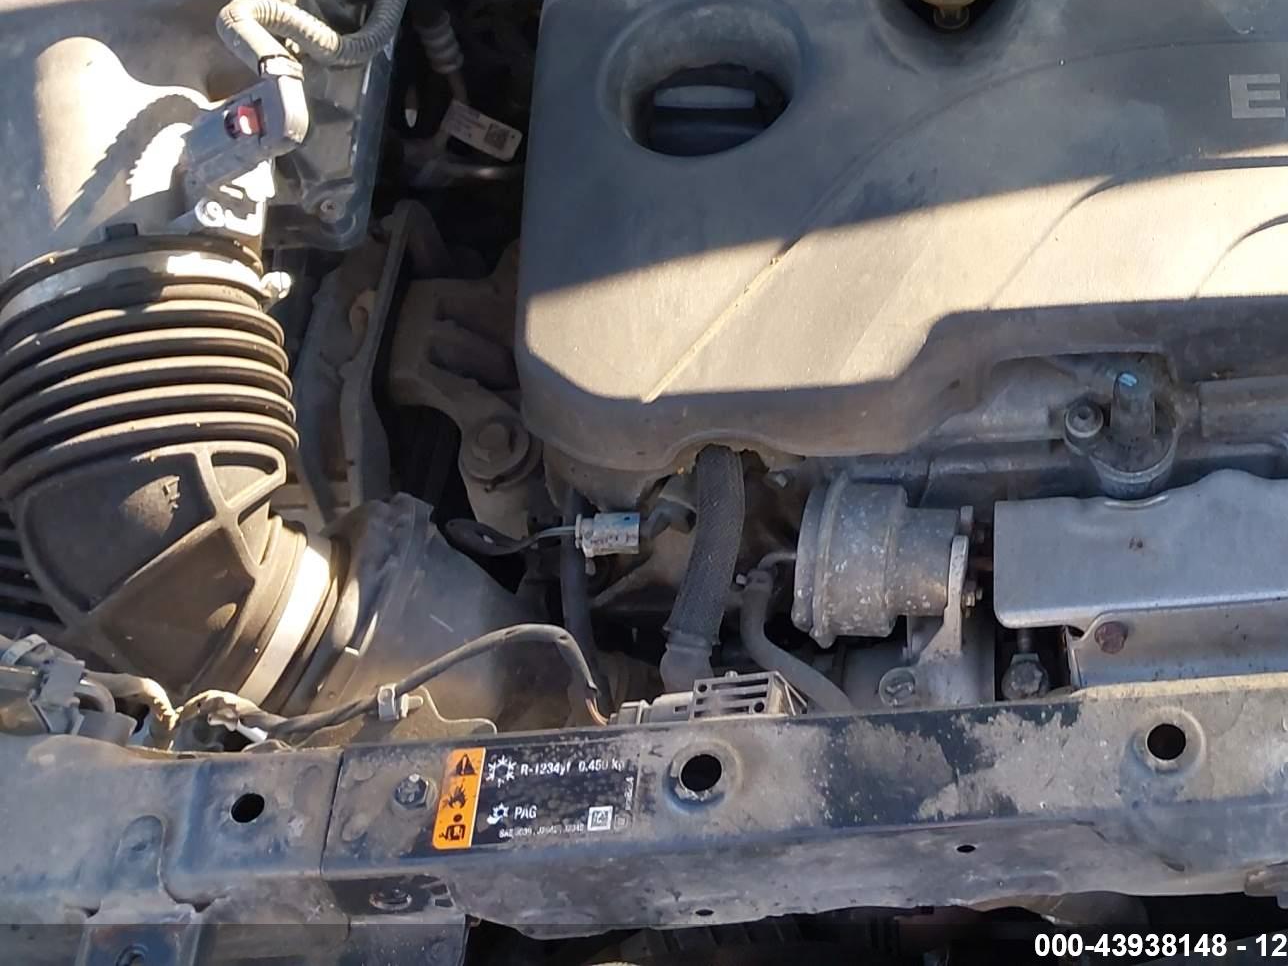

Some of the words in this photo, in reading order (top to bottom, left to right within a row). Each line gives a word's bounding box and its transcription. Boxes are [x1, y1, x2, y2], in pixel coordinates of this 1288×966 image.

[521, 762, 571, 776] R-1234yf
[578, 759, 609, 772] 0.450
[514, 805, 537, 819] PAG
